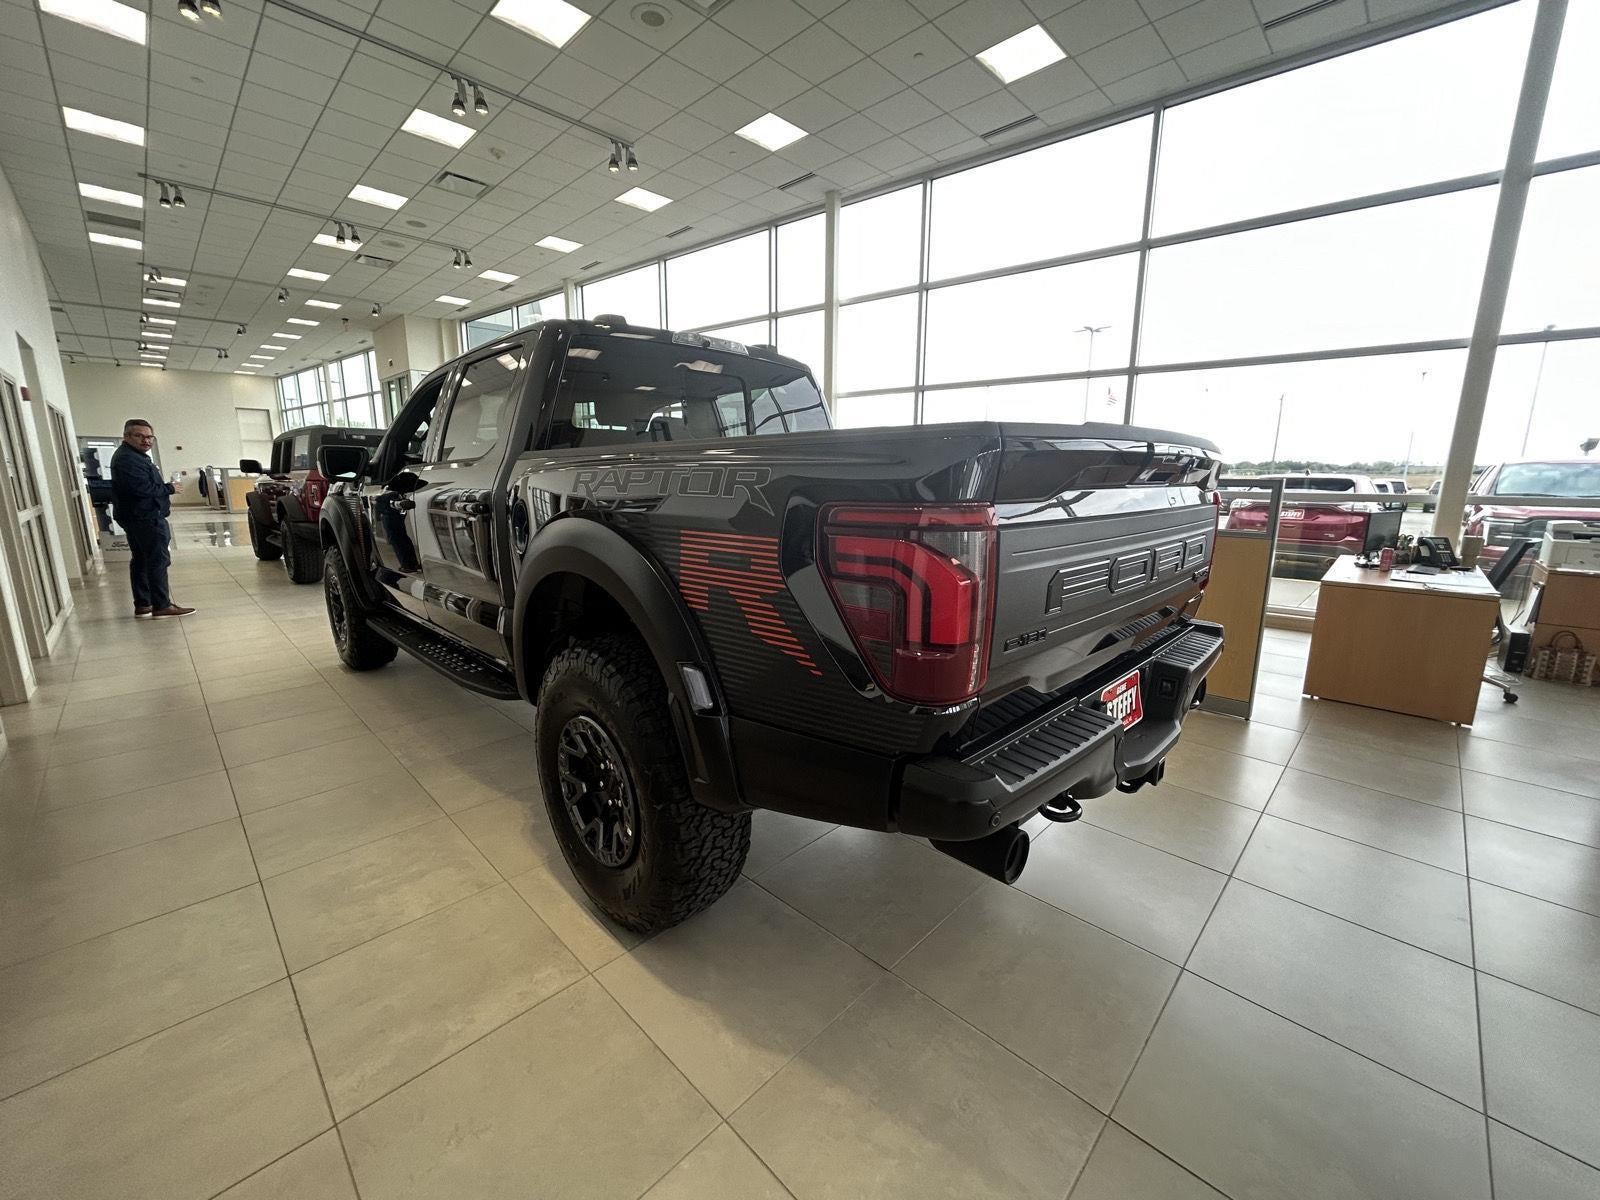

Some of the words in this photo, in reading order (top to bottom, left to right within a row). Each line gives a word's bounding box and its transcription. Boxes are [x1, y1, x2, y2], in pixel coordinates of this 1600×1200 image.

[571, 467, 775, 517] RAPTOR
[1045, 534, 1207, 616] FORD
[1106, 685, 1137, 719] STEFFY
